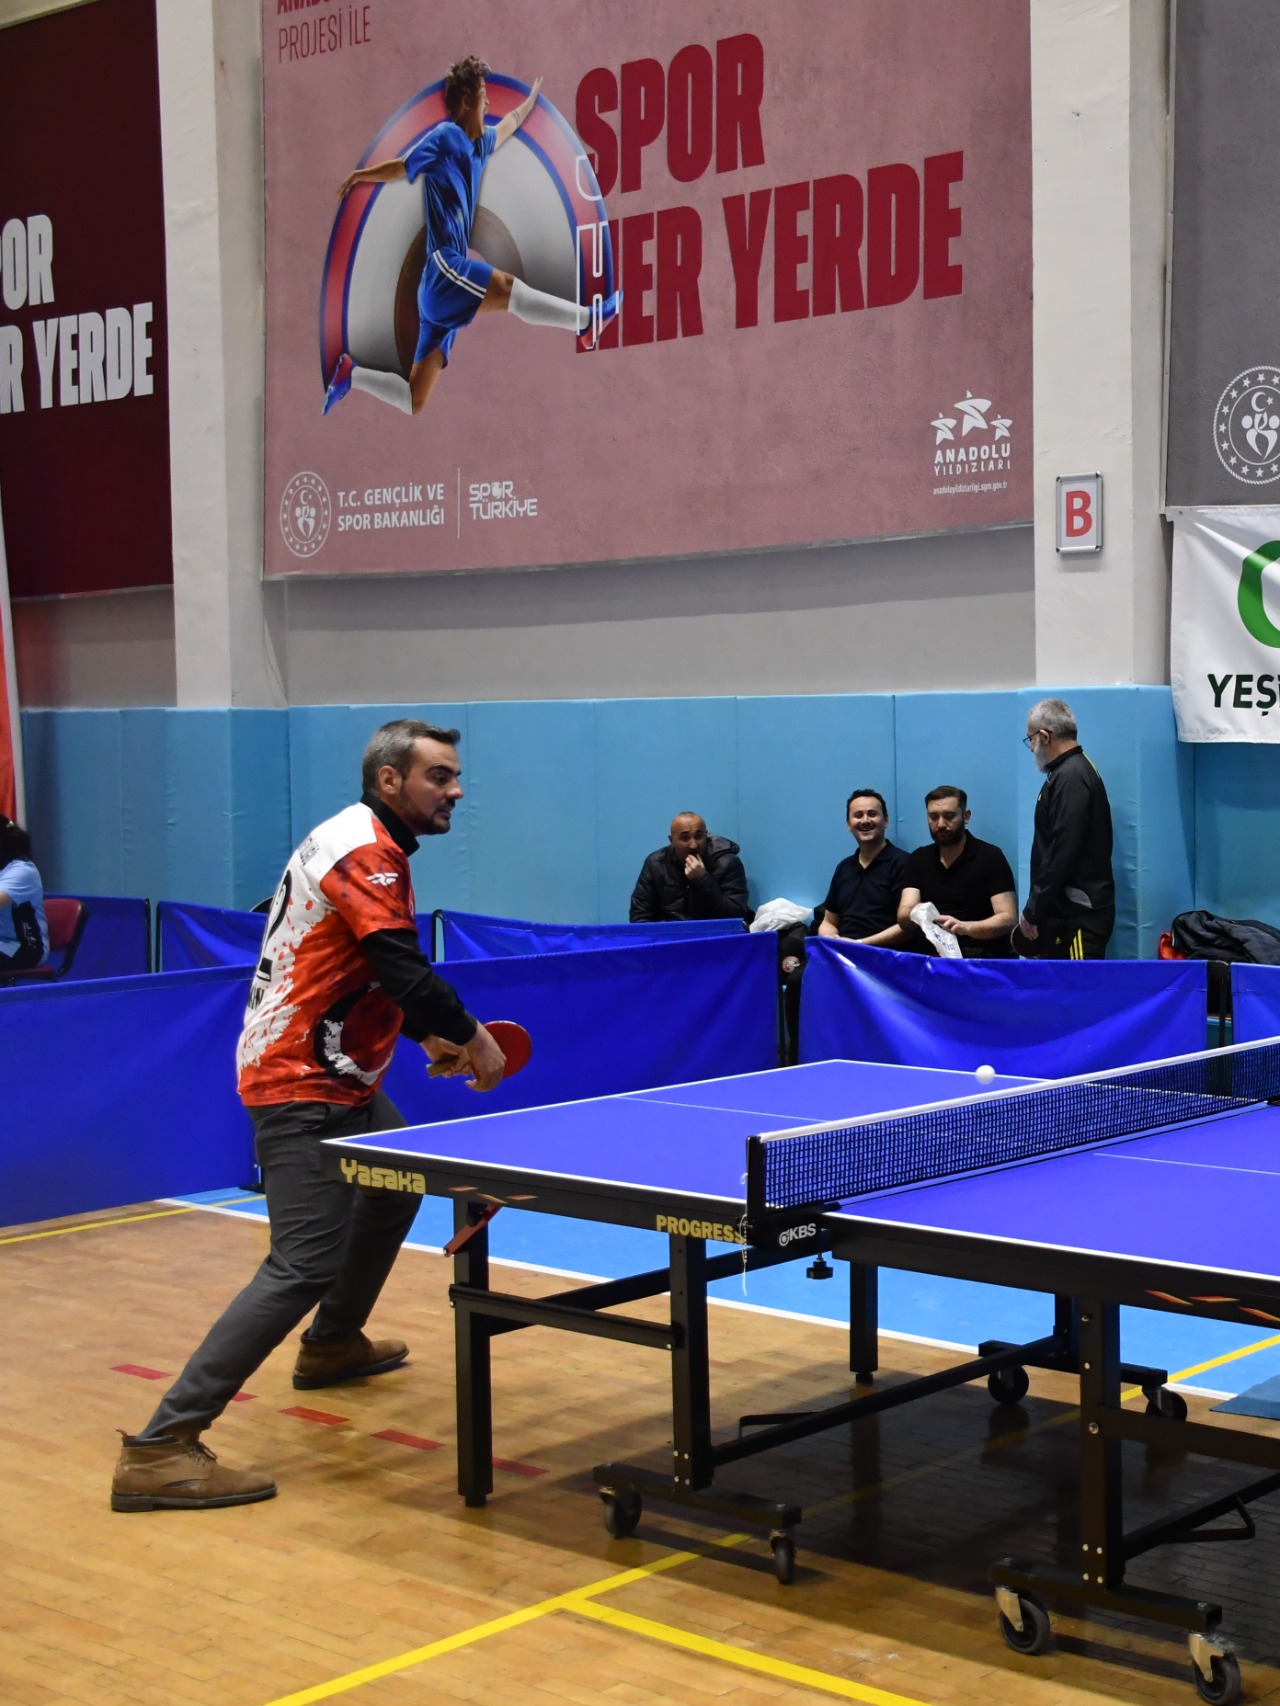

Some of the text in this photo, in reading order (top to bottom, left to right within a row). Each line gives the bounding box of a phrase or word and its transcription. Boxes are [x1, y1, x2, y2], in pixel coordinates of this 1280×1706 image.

[279, 5, 371, 64] PROJESİ İLE
[575, 33, 765, 200] SPOR
[0, 214, 55, 310] OR
[576, 150, 964, 354] HER YERDE
[32, 301, 154, 409] YERDE
[934, 443, 1011, 464] ANADOLU
[934, 459, 1011, 476] YILDIZLARI
[337, 482, 445, 508] T.C. GENÇLİK VE
[469, 481, 514, 501] SPOR
[469, 497, 538, 520] TÜRKİYE
[337, 505, 445, 532] SPOR BAKANLIĞI
[1065, 490, 1093, 537] B
[340, 1157, 427, 1195] Yasaka
